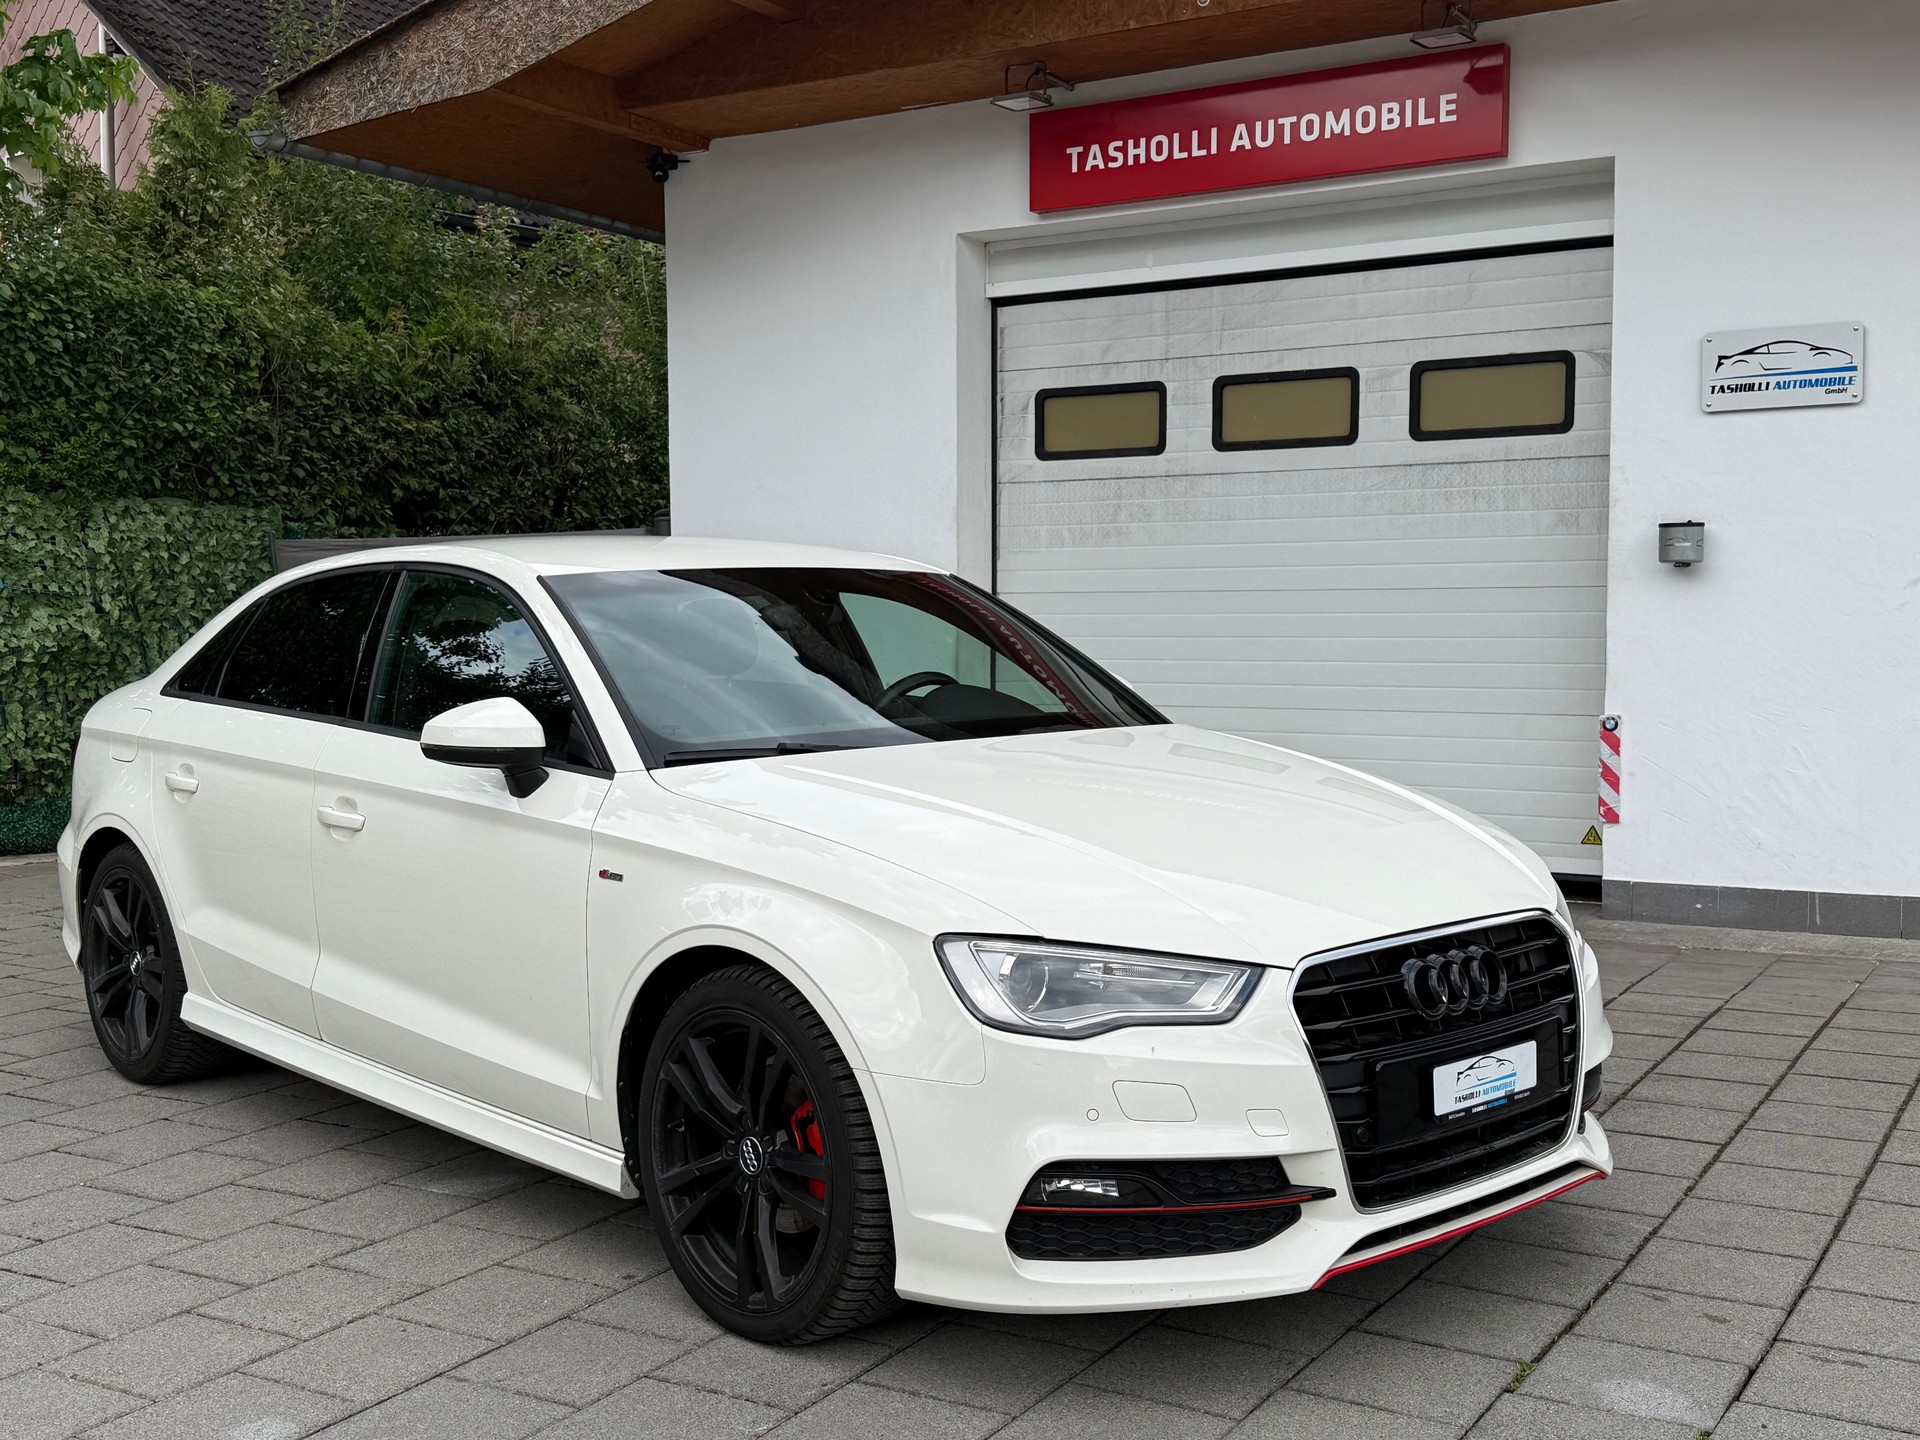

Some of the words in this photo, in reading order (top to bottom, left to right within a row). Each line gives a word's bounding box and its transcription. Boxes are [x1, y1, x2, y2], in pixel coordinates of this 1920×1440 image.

[1066, 126, 1218, 173] TASHOLLI
[1229, 92, 1458, 152] AUTOMOBILE
[1709, 382, 1770, 394] TASHOLLI
[1773, 376, 1857, 390] AUTOMOBILE
[1825, 387, 1848, 395] GmbH
